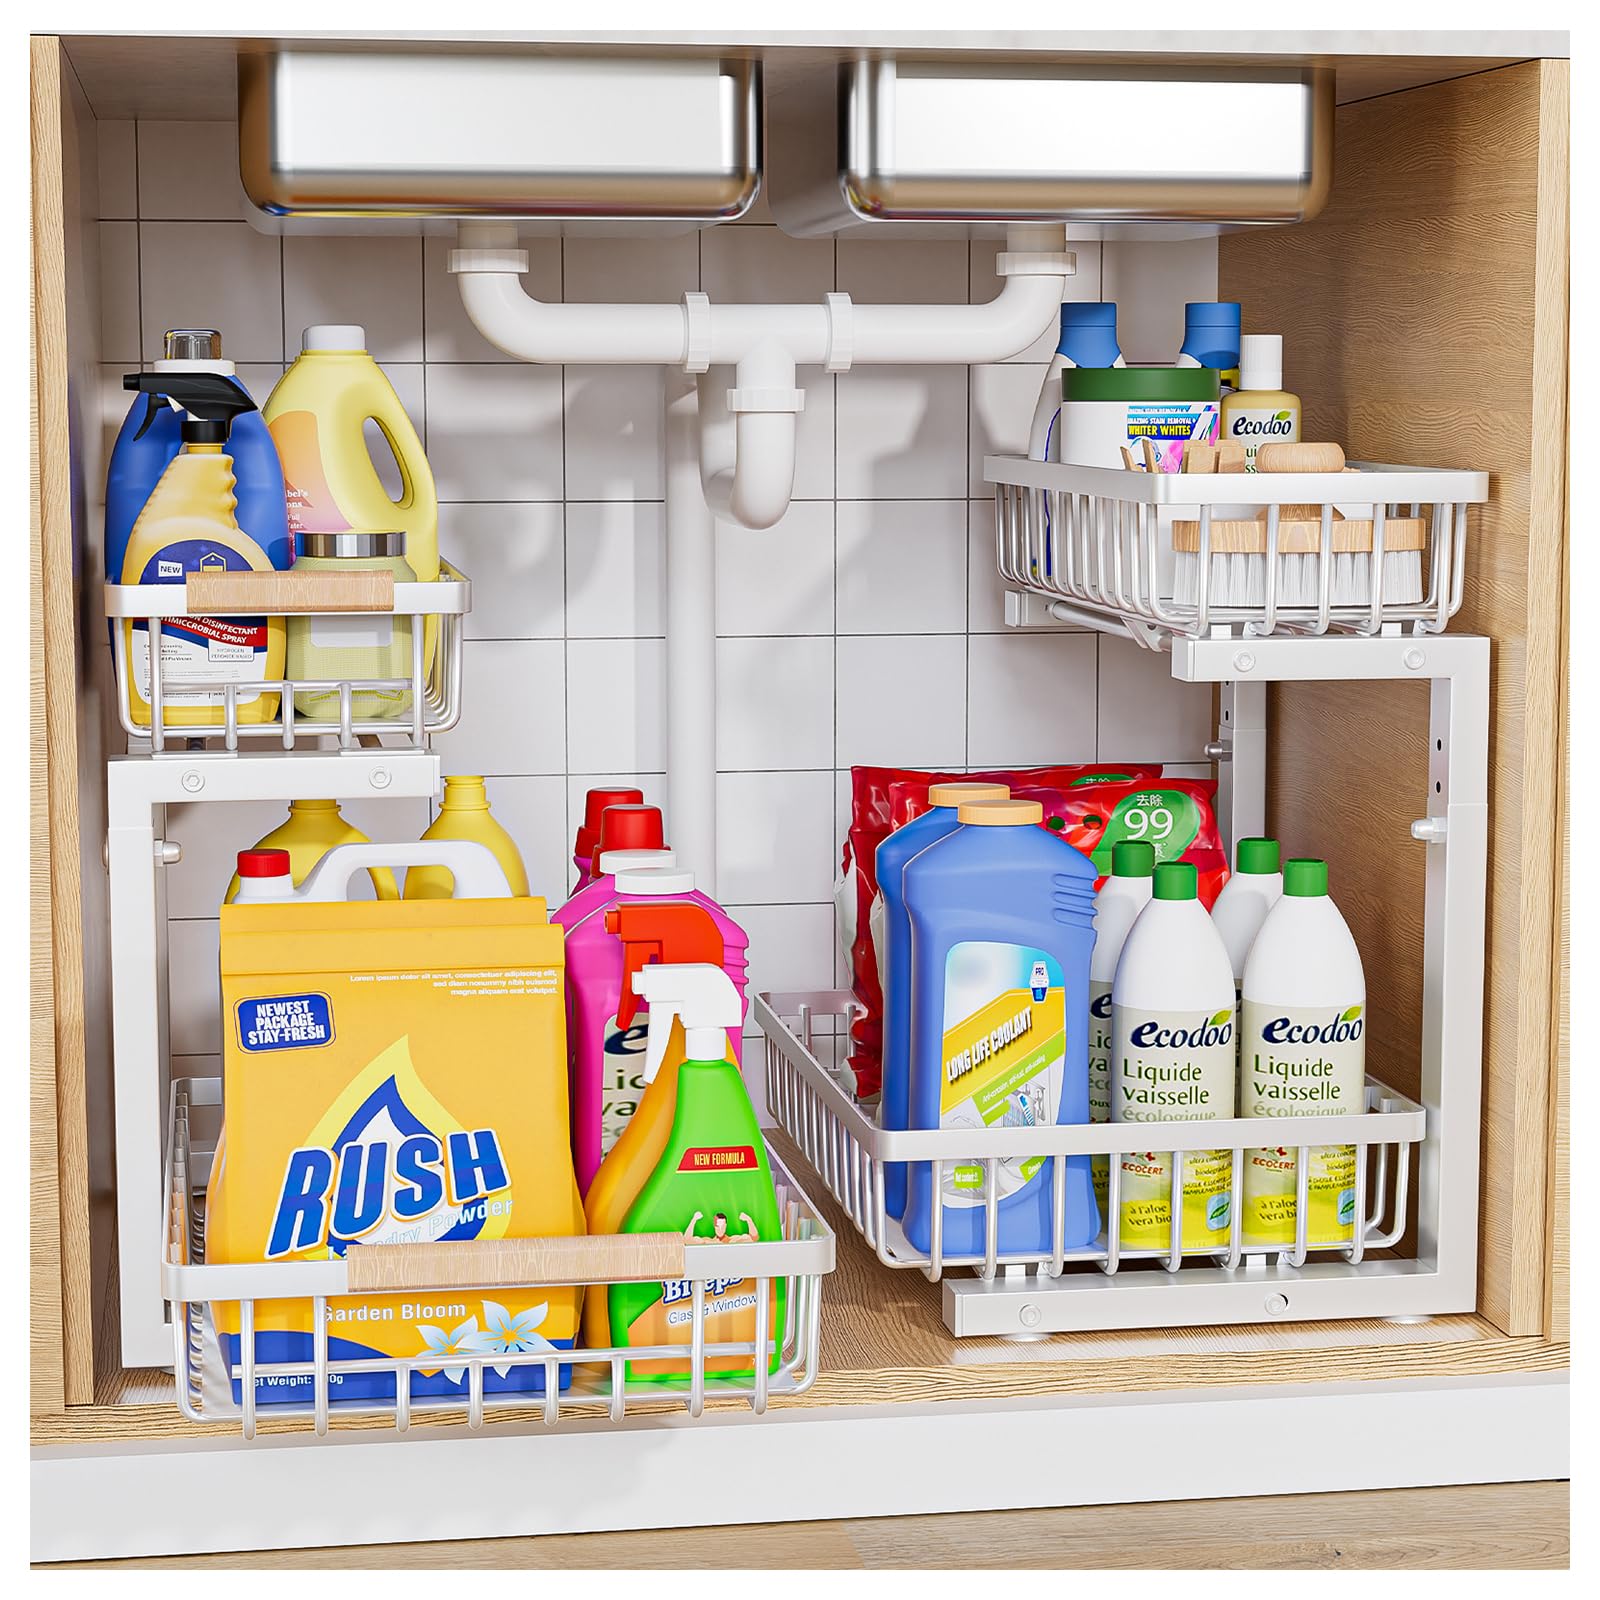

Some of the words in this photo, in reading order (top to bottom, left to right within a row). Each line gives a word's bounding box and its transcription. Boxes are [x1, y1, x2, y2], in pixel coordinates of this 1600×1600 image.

[1128, 425, 1158, 436] WHITER
[1160, 425, 1191, 436] WHITES
[1233, 413, 1292, 435] ecodoo
[160, 565, 181, 574] NEW
[202, 617, 258, 635] DISINFECTANT
[221, 633, 247, 644] SPRAY
[1136, 794, 1163, 806] 去除
[1124, 808, 1174, 840] 99
[350, 974, 375, 982] Lorem
[376, 974, 399, 982] ipsum
[256, 1000, 310, 1018] NEWEST
[255, 1012, 316, 1031] PACKAGE
[1262, 1013, 1362, 1044] ecodoo
[248, 1025, 326, 1046] STAY-FRESH
[1130, 1017, 1232, 1048] ecodoo
[946, 1049, 974, 1083] LONG
[971, 1034, 992, 1064] LIFE
[990, 1005, 1033, 1053] COOLANT
[1123, 1058, 1202, 1085] Liquide
[1254, 1054, 1334, 1081] Liquide
[1122, 1085, 1210, 1106] vaisselle
[1253, 1081, 1341, 1101] vaisselle
[1089, 1098, 1110, 1108] oux
[694, 1153, 710, 1166] NEW
[712, 1152, 745, 1165] FORMULA
[1252, 1157, 1295, 1170] ECOCERT
[1121, 1162, 1163, 1175] ECOCERT
[265, 1129, 511, 1259] RUSH
[429, 1199, 513, 1235] Powder
[1129, 1215, 1153, 1226] vera
[1156, 1213, 1172, 1224] bio
[1259, 1211, 1284, 1221] vera
[1287, 1208, 1297, 1219] bi
[326, 1304, 394, 1321] Garden
[401, 1303, 467, 1320] Bloom
[668, 1310, 693, 1325] Glas
[255, 1377, 264, 1387] et
[267, 1376, 312, 1387] Weight:
